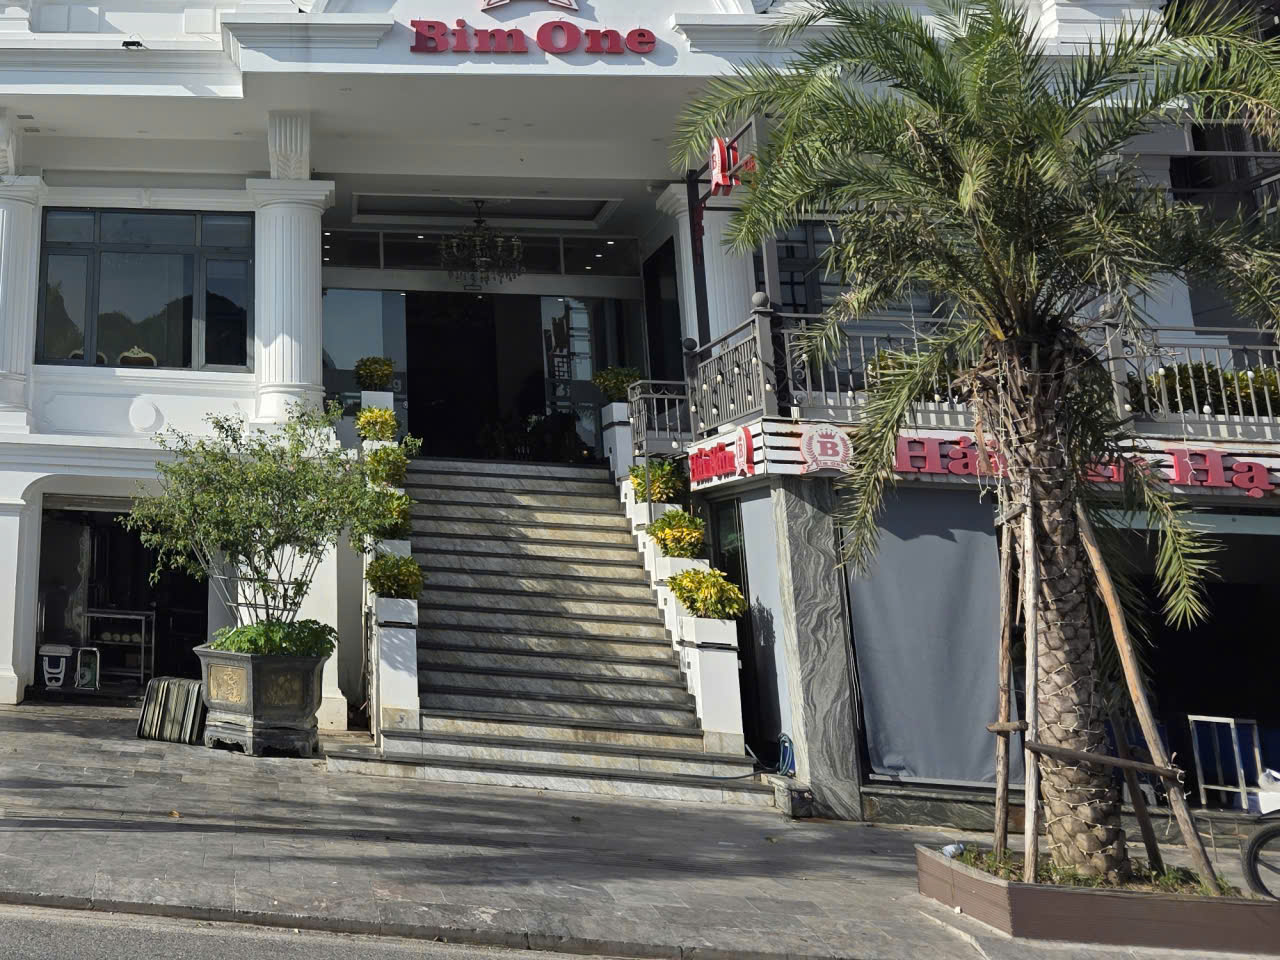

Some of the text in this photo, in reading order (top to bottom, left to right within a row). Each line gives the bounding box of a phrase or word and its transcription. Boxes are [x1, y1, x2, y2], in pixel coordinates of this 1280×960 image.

[410, 18, 657, 55] Bim One
[817, 440, 840, 457] B
